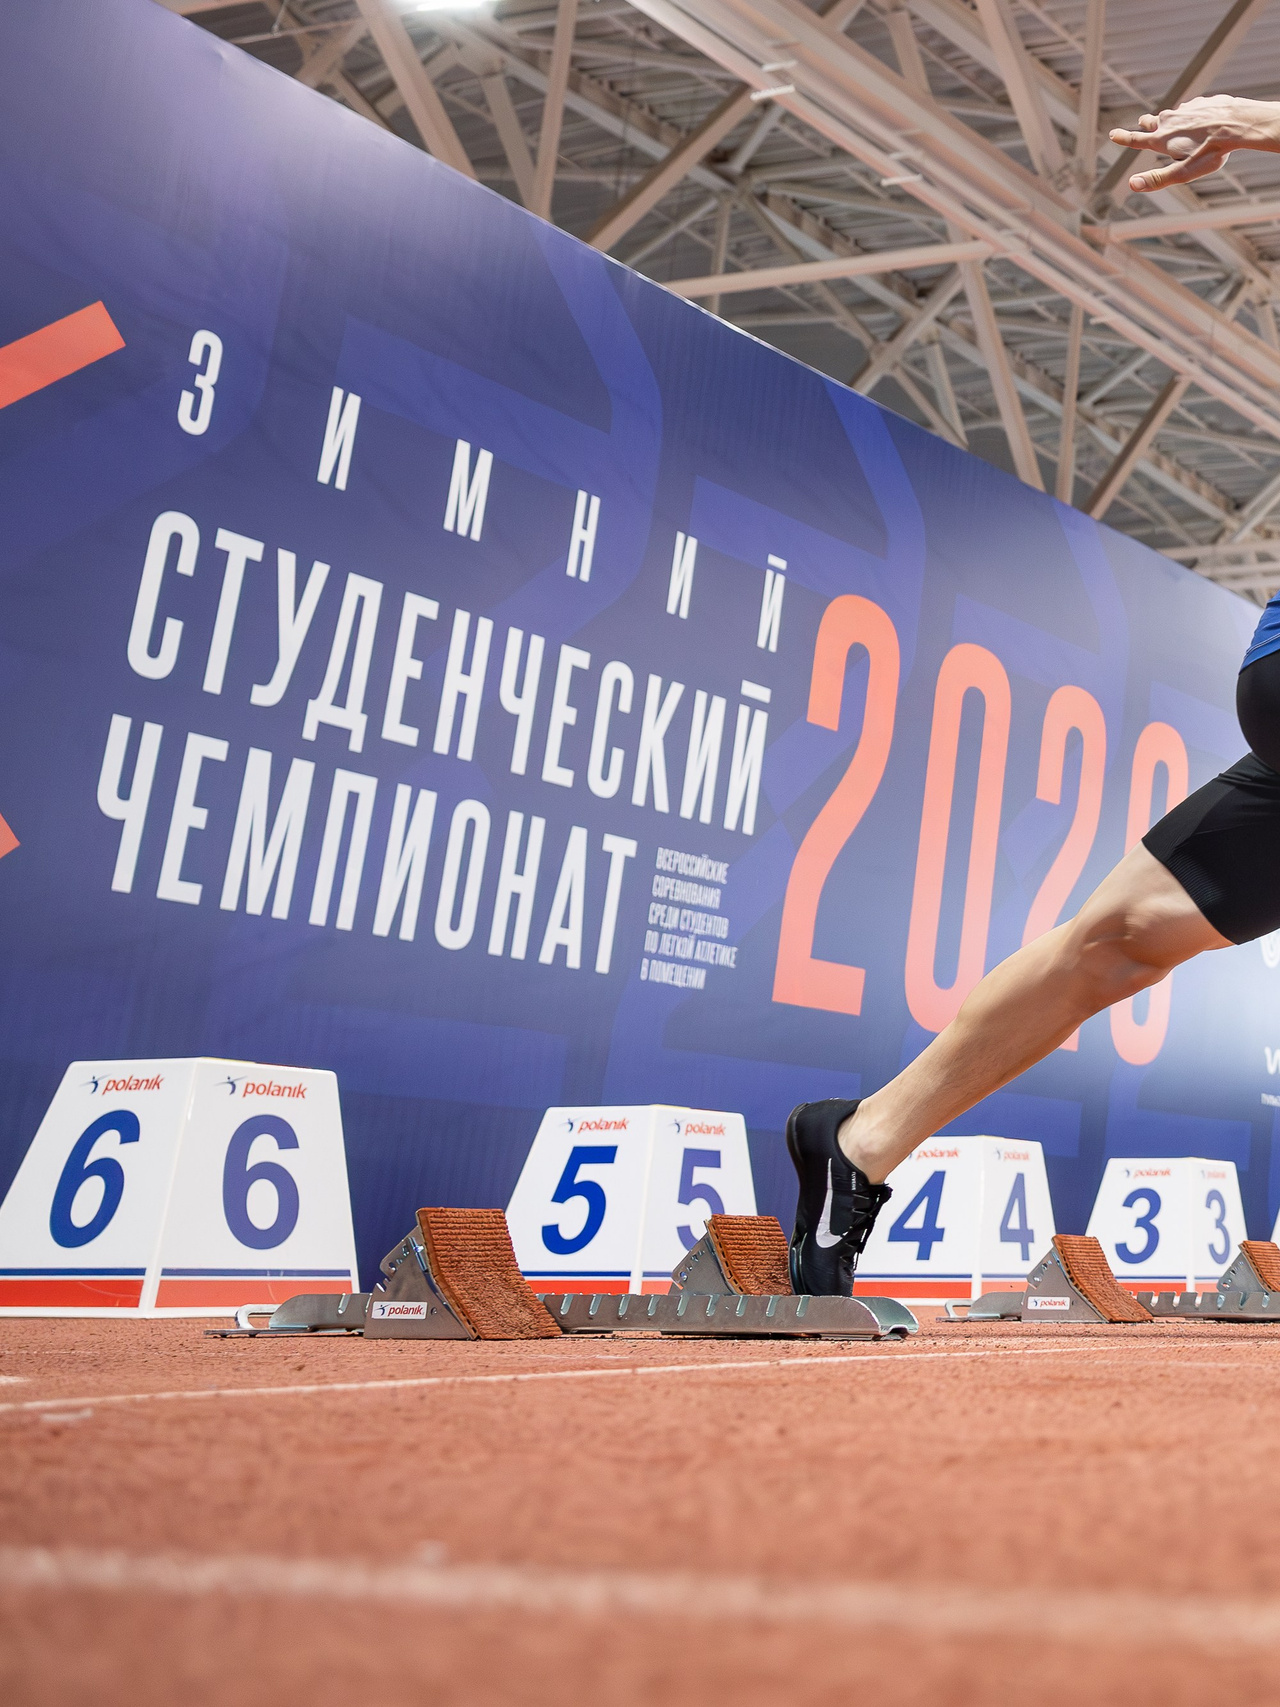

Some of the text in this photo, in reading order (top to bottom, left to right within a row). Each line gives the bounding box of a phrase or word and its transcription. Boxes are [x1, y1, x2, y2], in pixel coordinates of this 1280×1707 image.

[127, 510, 771, 835] СТУДЕНЧЕСКИЙ
[97, 713, 637, 974] ЧЕМПИОНАТ
[102, 1073, 165, 1095] polanik
[242, 1080, 308, 1099] polanik
[578, 1117, 630, 1133] polanik
[684, 1122, 726, 1136] polanik
[50, 1109, 140, 1248] 6
[222, 1114, 300, 1250] 6
[541, 1145, 619, 1255] 5
[676, 1147, 725, 1251] 5
[887, 1170, 946, 1261] 4
[1000, 1172, 1035, 1261] 4
[1115, 1187, 1161, 1264] 3
[1205, 1189, 1230, 1265] 3
[387, 1305, 424, 1317] polanik
